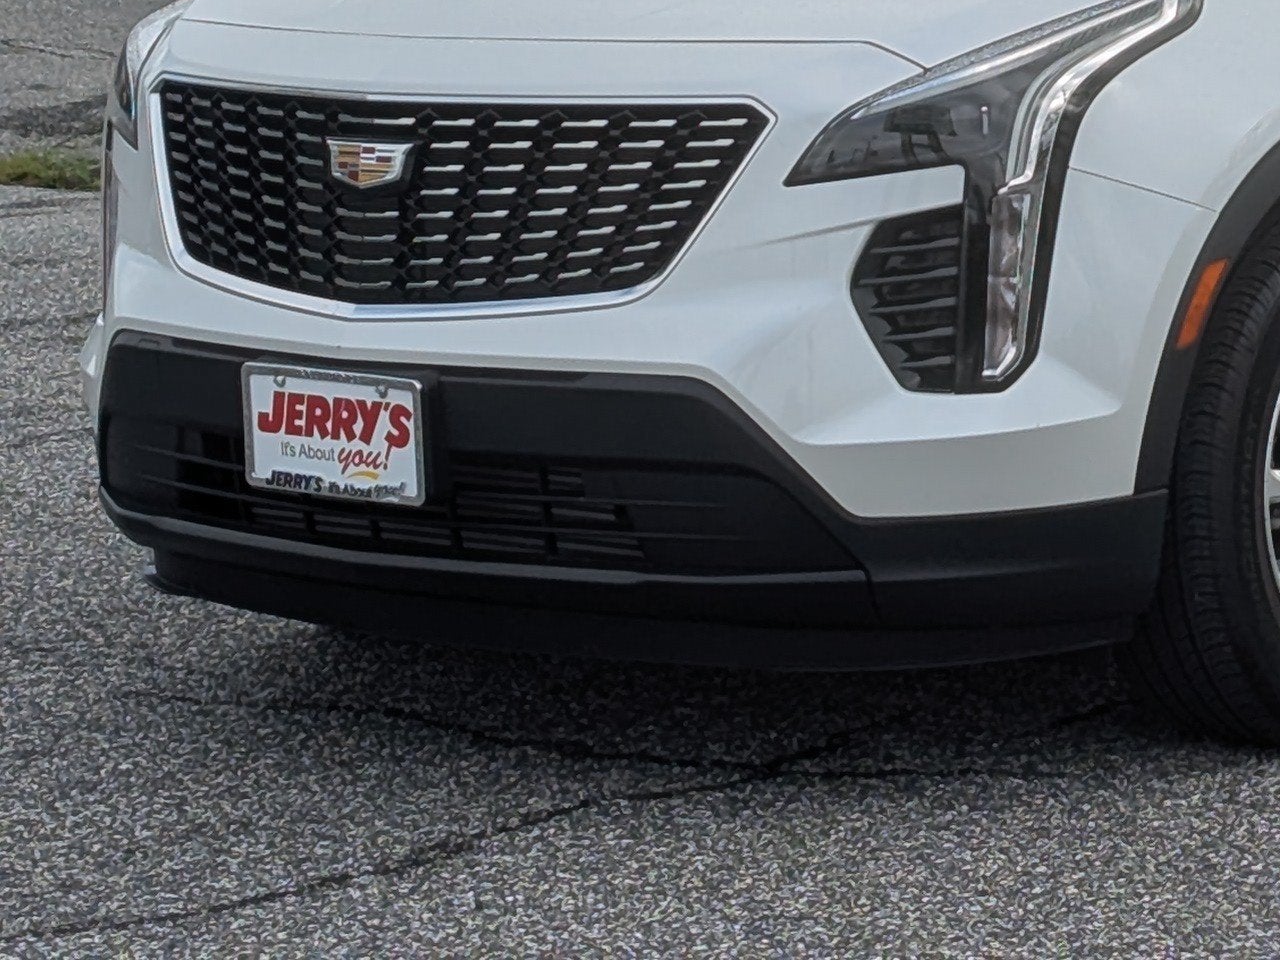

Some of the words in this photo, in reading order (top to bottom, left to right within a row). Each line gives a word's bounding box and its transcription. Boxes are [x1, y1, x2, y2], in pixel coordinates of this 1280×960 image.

[258, 391, 413, 449] JERRY'S
[281, 442, 297, 457] It's
[300, 444, 335, 462] About
[338, 444, 393, 475] you!
[266, 471, 323, 493] JERRY'S
